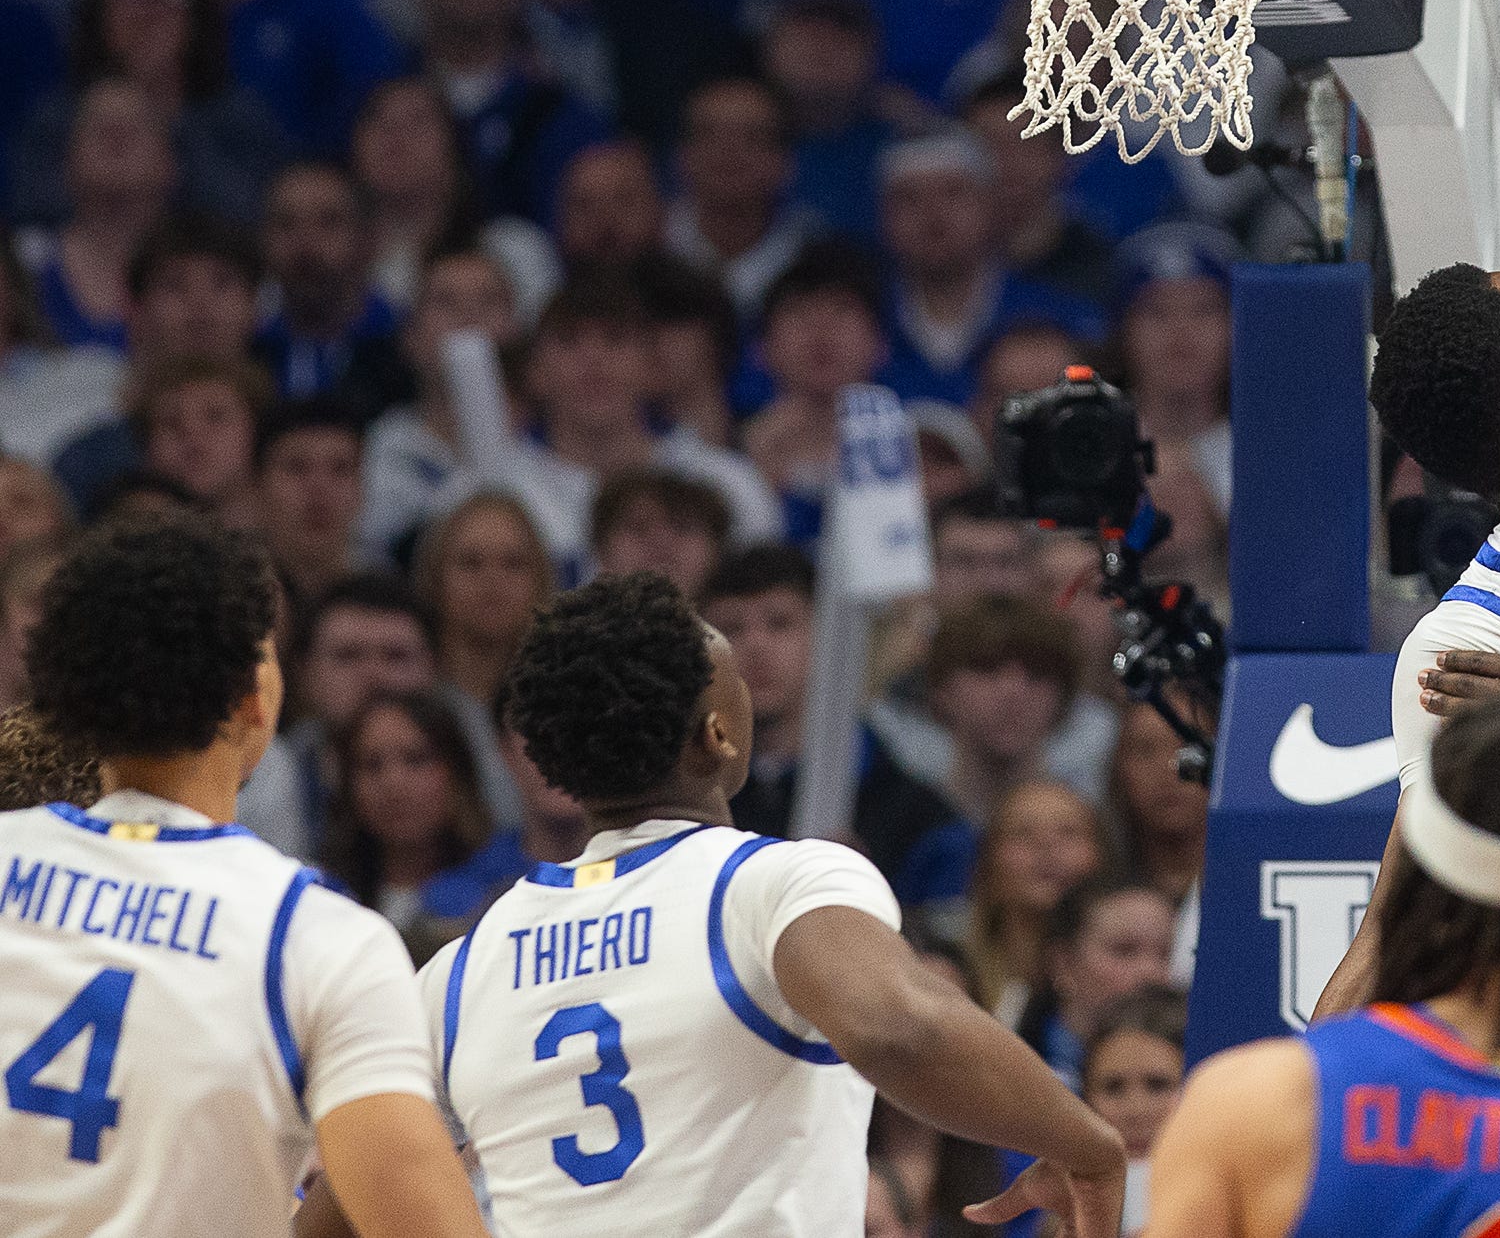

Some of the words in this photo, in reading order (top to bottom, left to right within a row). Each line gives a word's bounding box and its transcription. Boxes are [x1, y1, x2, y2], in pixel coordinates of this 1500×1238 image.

[0, 858, 219, 960] MITCHELL
[508, 906, 653, 989] THIERO
[5, 967, 136, 1163] 4
[533, 1002, 645, 1187] 3
